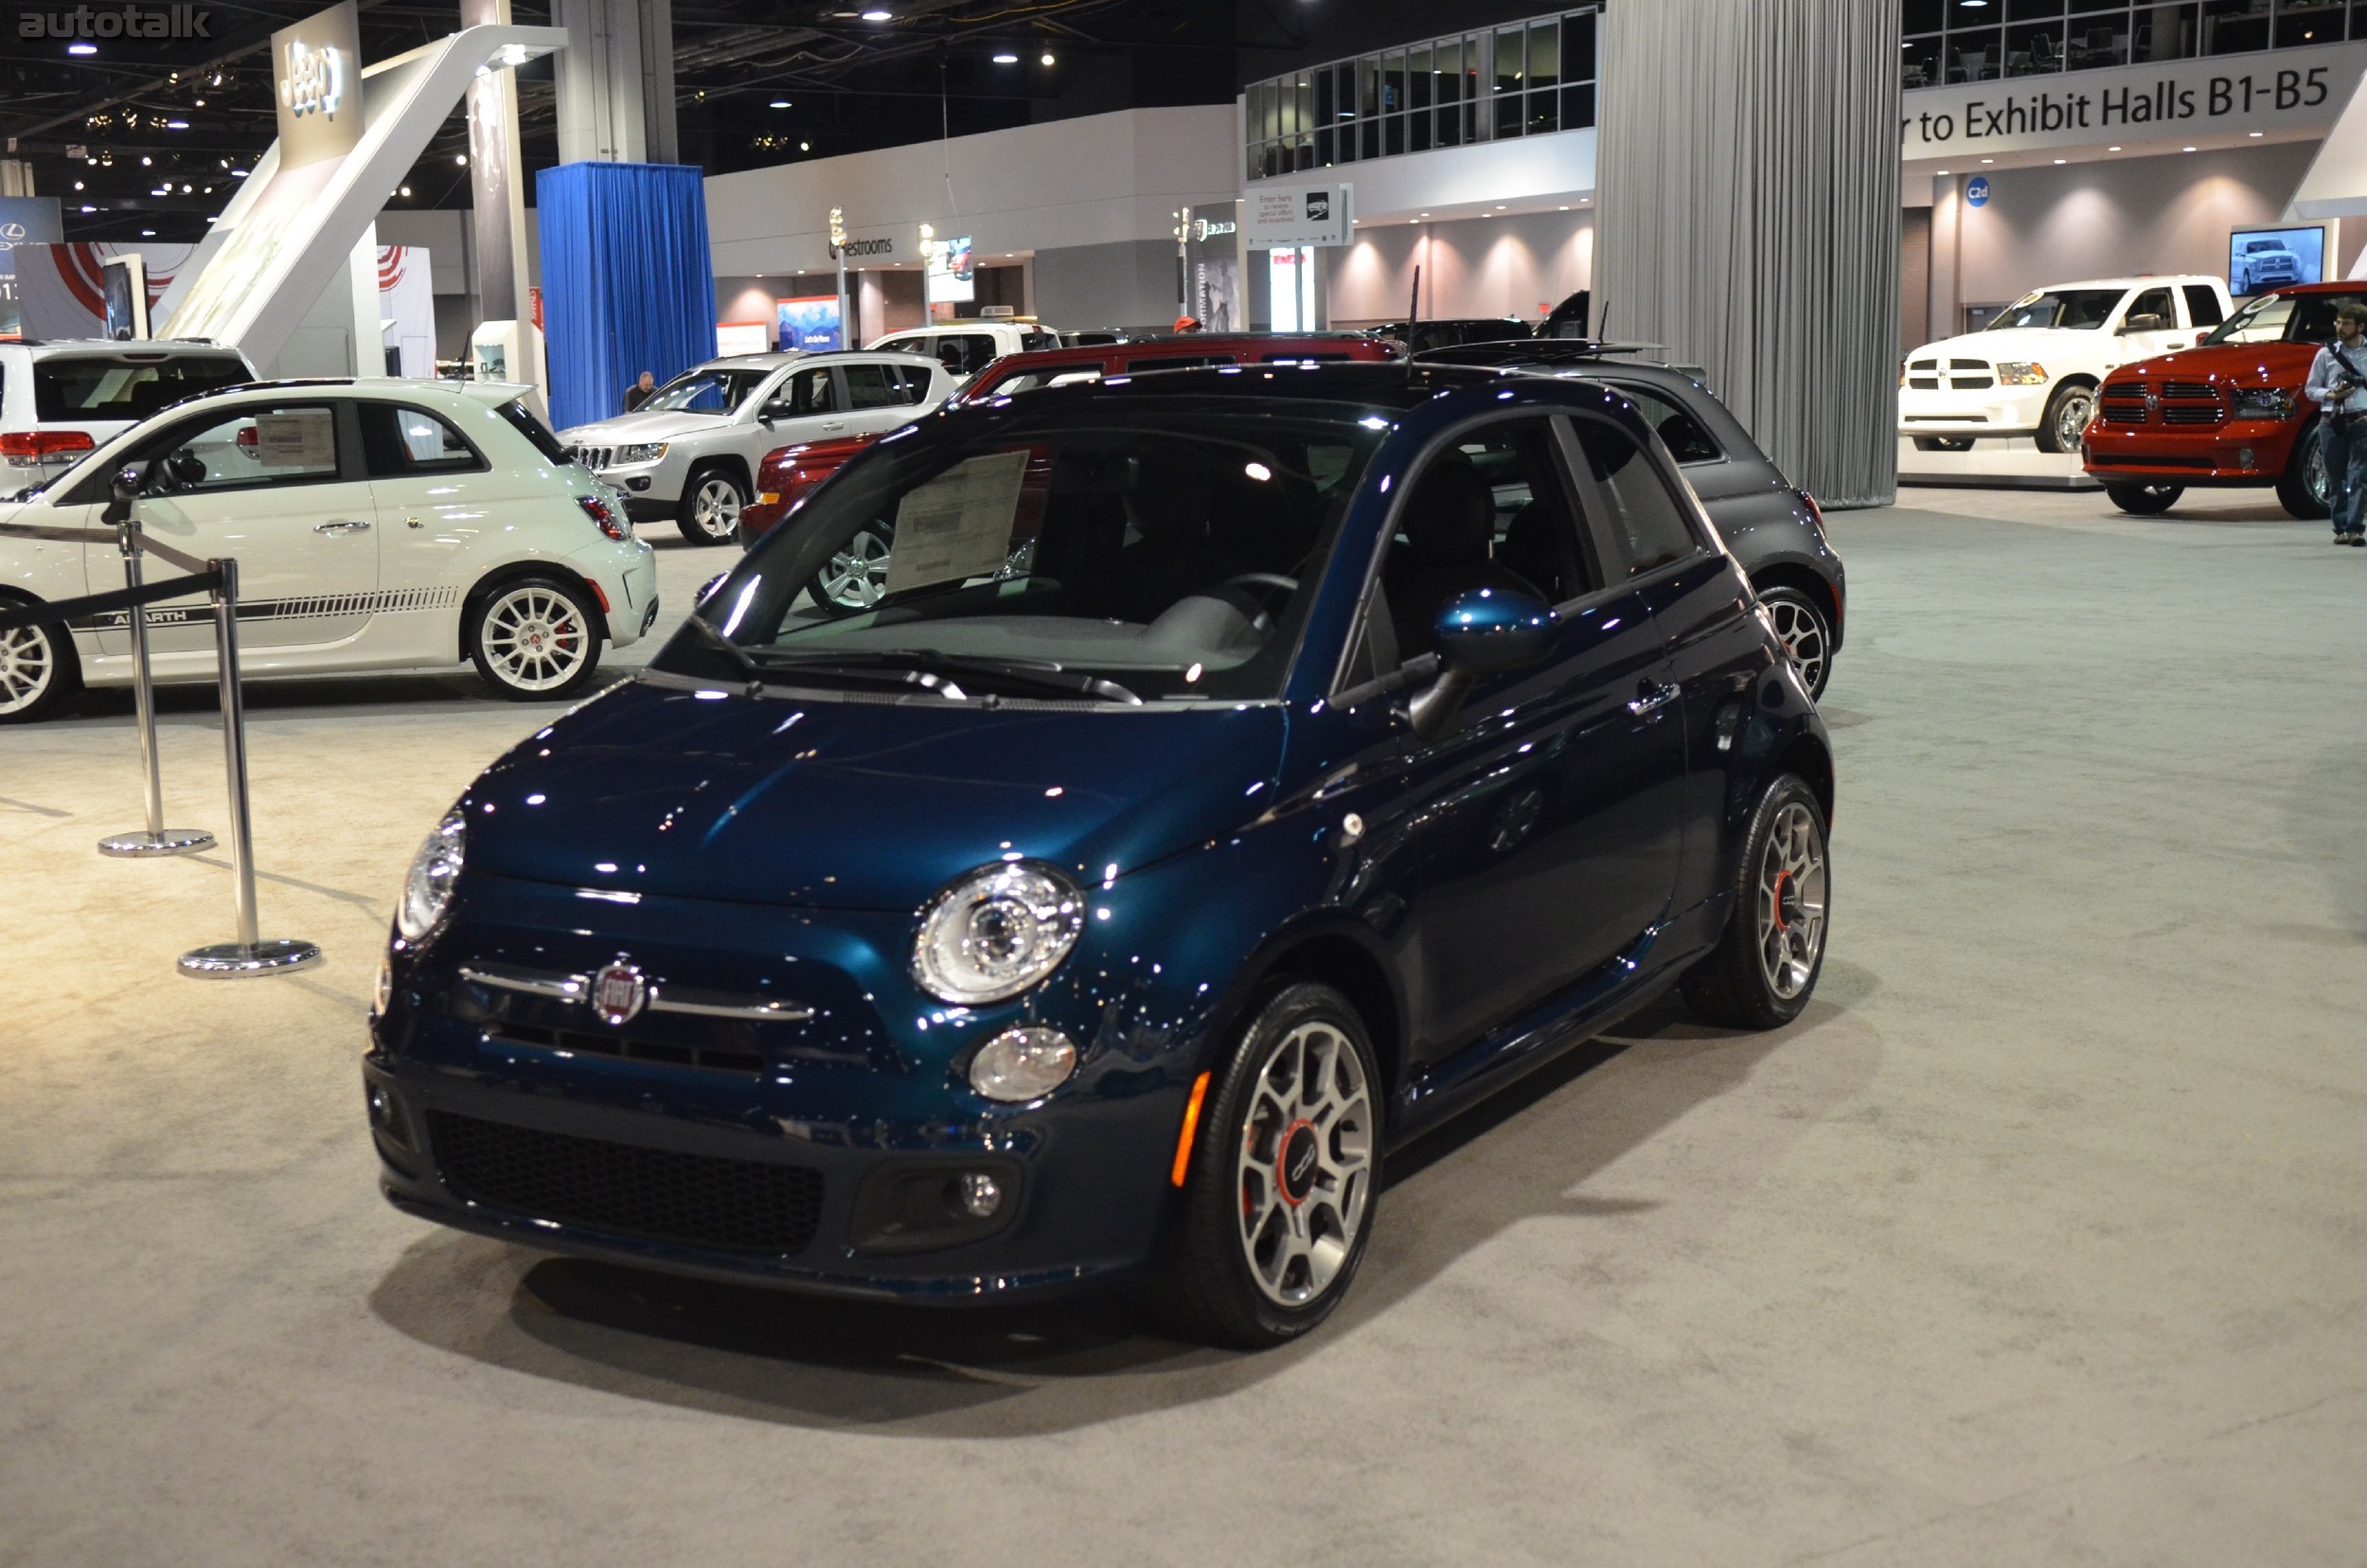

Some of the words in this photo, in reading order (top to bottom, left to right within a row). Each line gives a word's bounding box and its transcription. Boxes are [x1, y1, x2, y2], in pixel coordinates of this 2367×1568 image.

[279, 42, 340, 117] Jeep
[1920, 111, 1954, 143] to
[1966, 93, 2091, 138] Exhibit
[2101, 80, 2196, 126] Halls
[2208, 66, 2329, 116] B1-B5
[1259, 194, 1276, 204] Enter
[1277, 194, 1292, 203] here
[842, 239, 893, 258] estrooms
[1197, 263, 1208, 332] FORMATION
[603, 977, 635, 1009] FIAT
